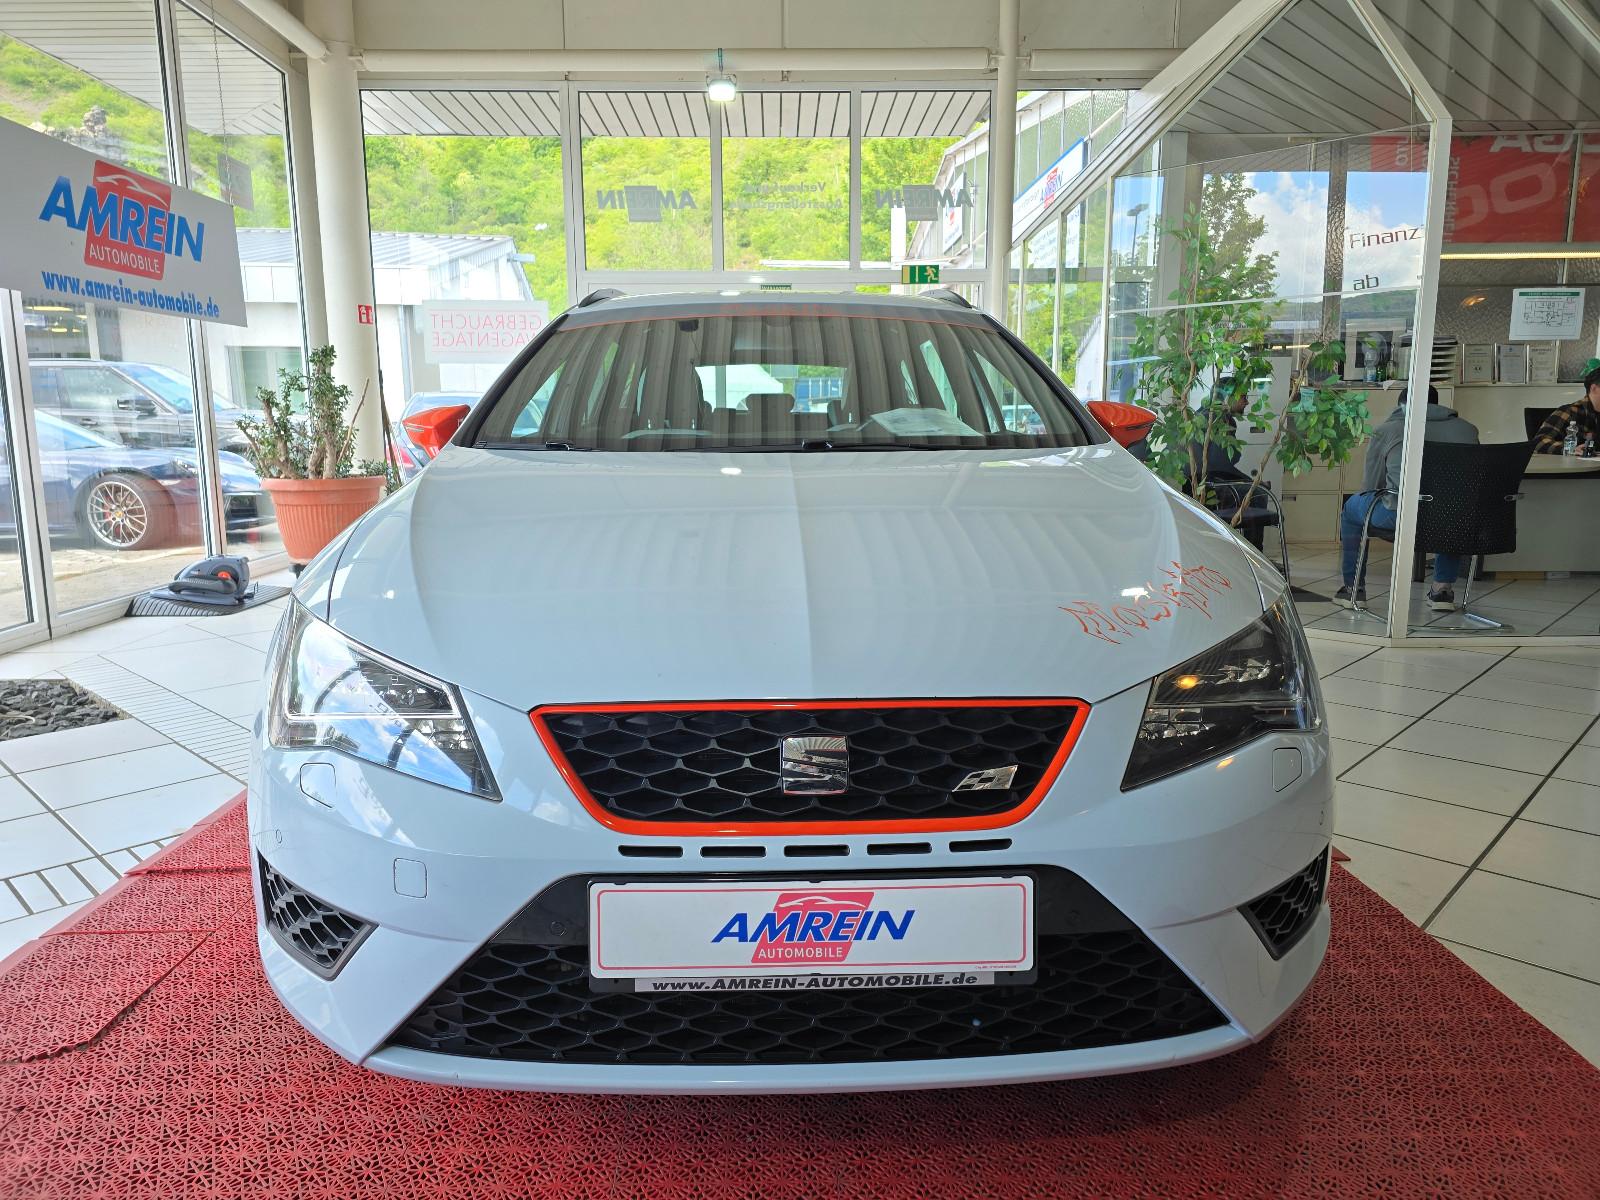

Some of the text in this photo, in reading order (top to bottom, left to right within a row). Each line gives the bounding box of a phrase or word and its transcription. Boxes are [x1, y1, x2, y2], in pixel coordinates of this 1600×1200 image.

[38, 175, 205, 263] AMREIN
[1350, 224, 1424, 248] Finanz
[89, 243, 161, 274] AUTOMOBILE
[41, 270, 220, 318] www.amrein-automobile.de
[1353, 274, 1380, 291] ab
[710, 910, 916, 943] AMREIN
[758, 947, 843, 959] AUTOMOBILE
[652, 973, 979, 991] www.AMREIN-AUTOMOBILE.de
